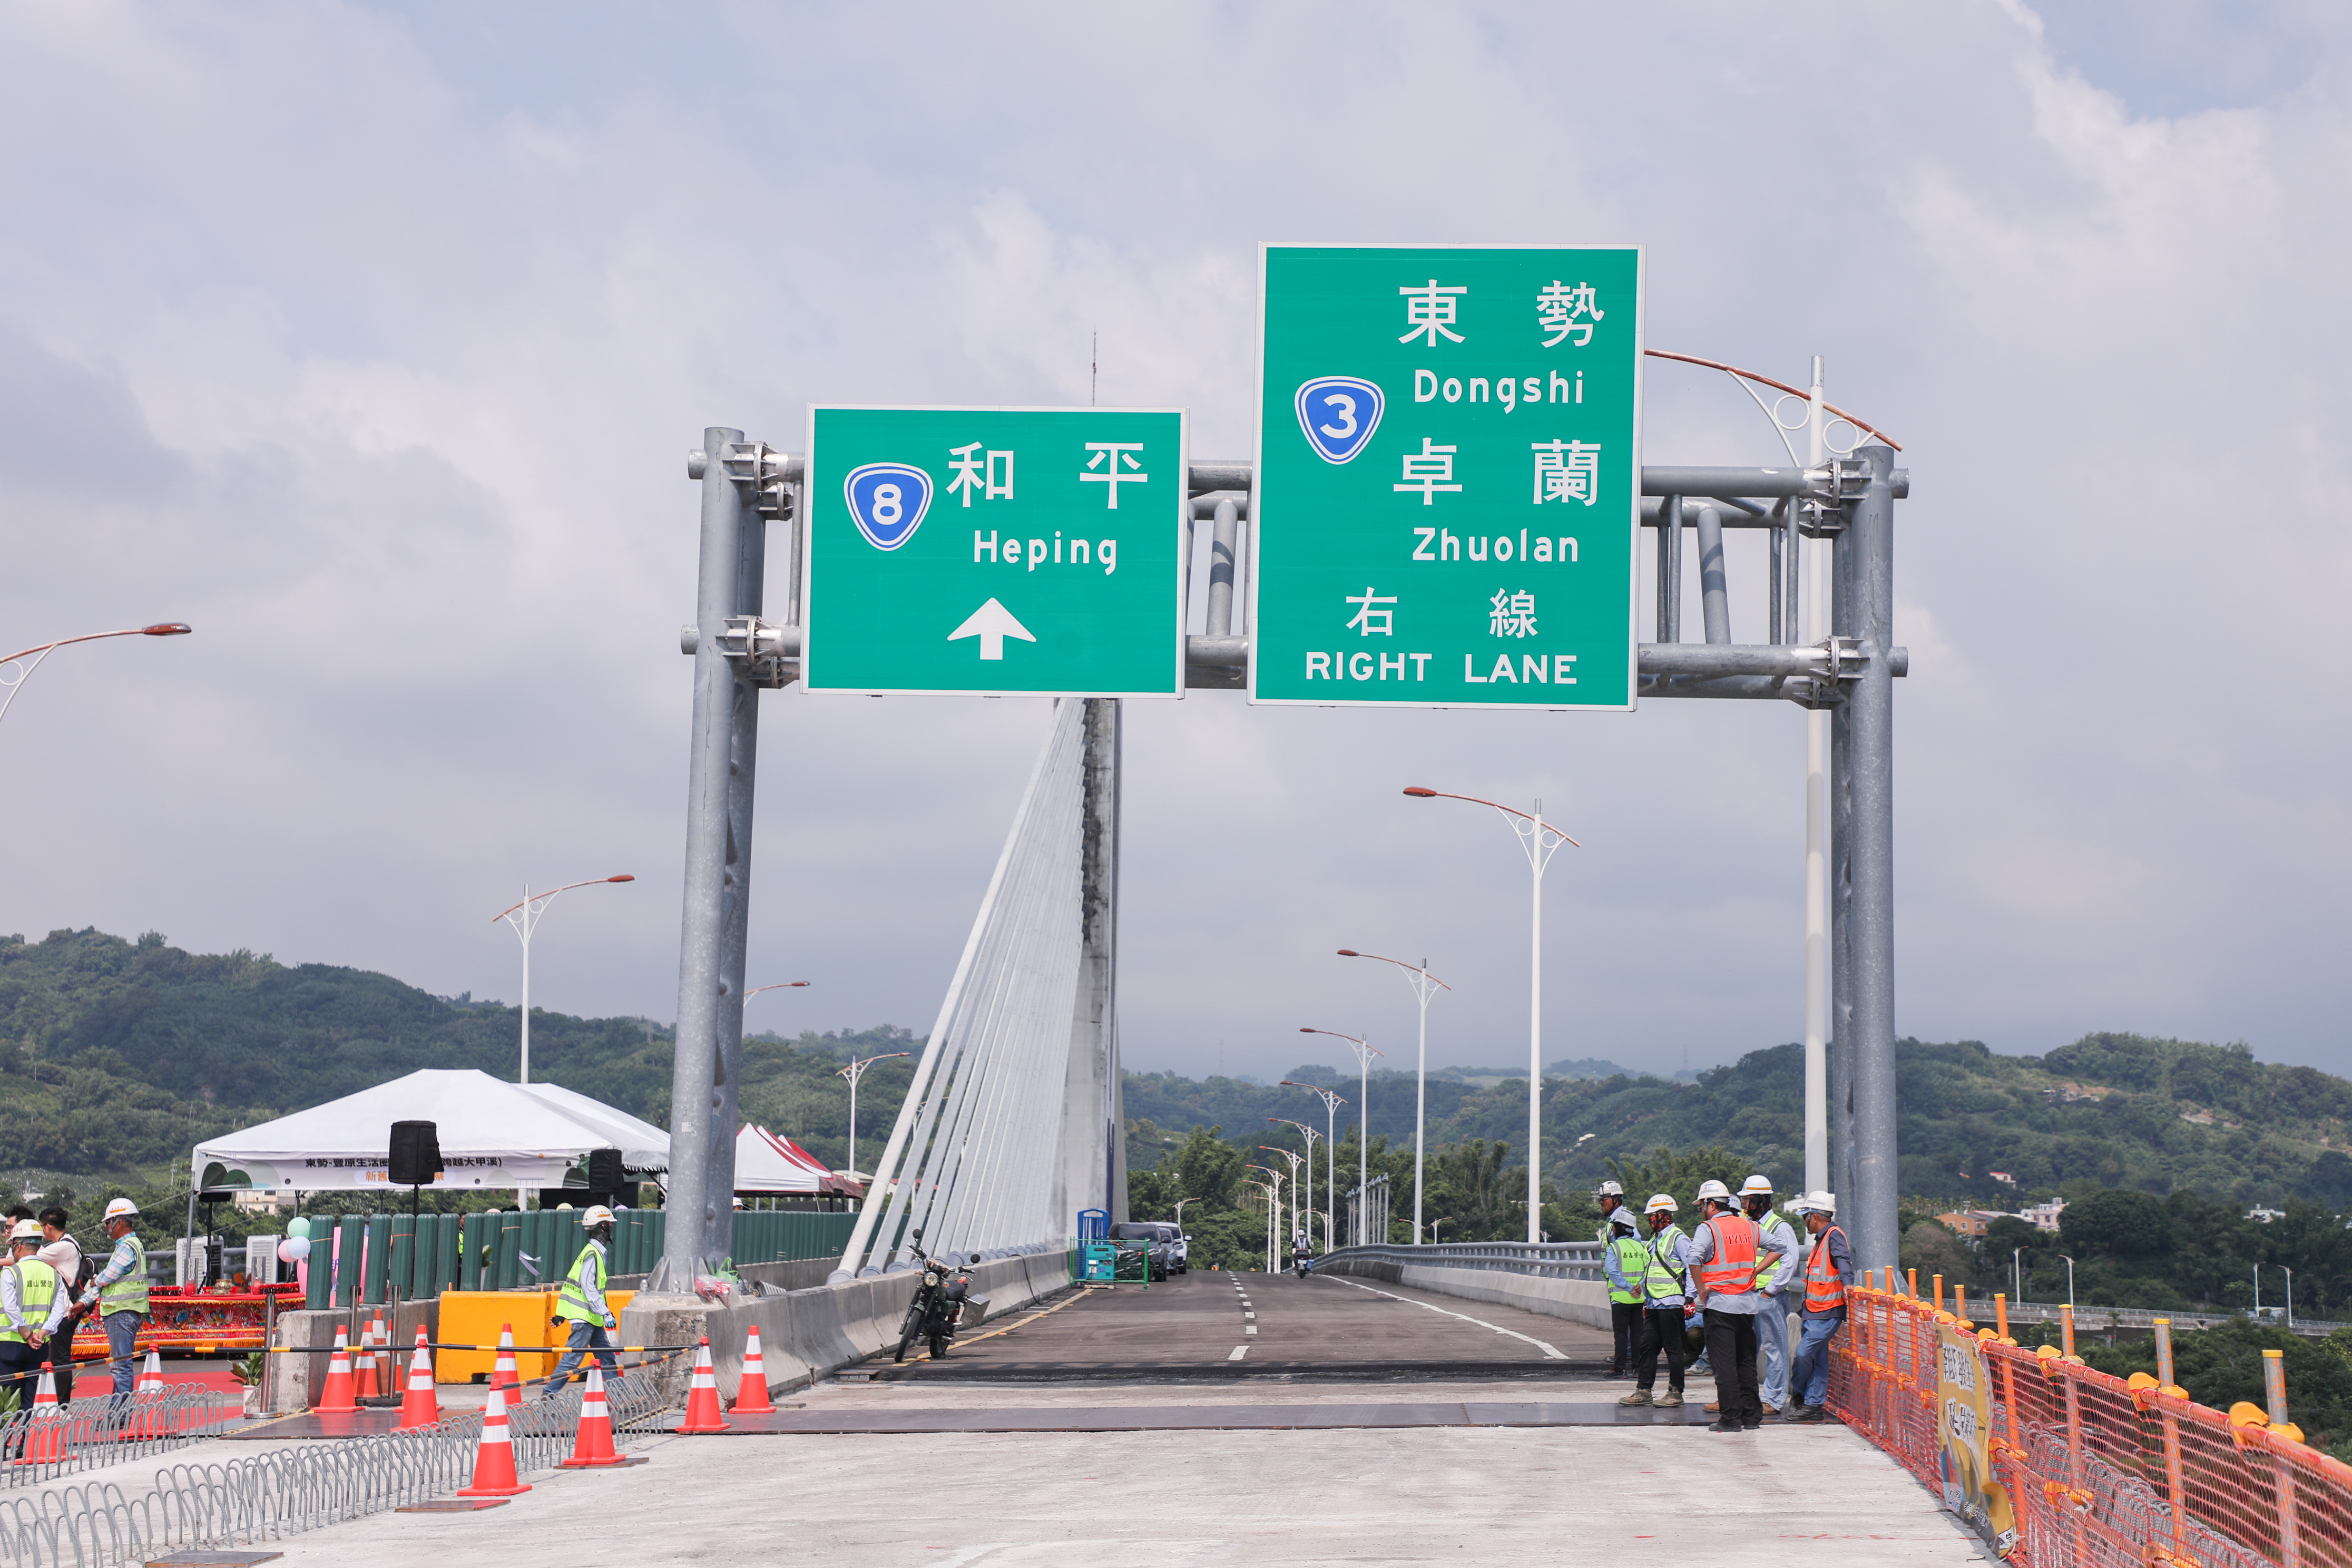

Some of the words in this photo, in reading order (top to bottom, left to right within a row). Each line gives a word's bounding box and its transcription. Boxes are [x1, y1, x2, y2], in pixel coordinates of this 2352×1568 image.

[1399, 279, 1605, 348] 東勢
[1414, 370, 1584, 414] Dongshi
[1319, 394, 1358, 439] 3
[946, 441, 1149, 509] 和平
[1394, 437, 1602, 507] 卓蘭
[872, 483, 903, 525] 8
[974, 530, 1117, 576] Heping
[1412, 527, 1579, 563] Zhuolan
[1346, 586, 1538, 639] 右線
[1306, 652, 1433, 682] RIGHT
[1465, 654, 1578, 684] LANE
